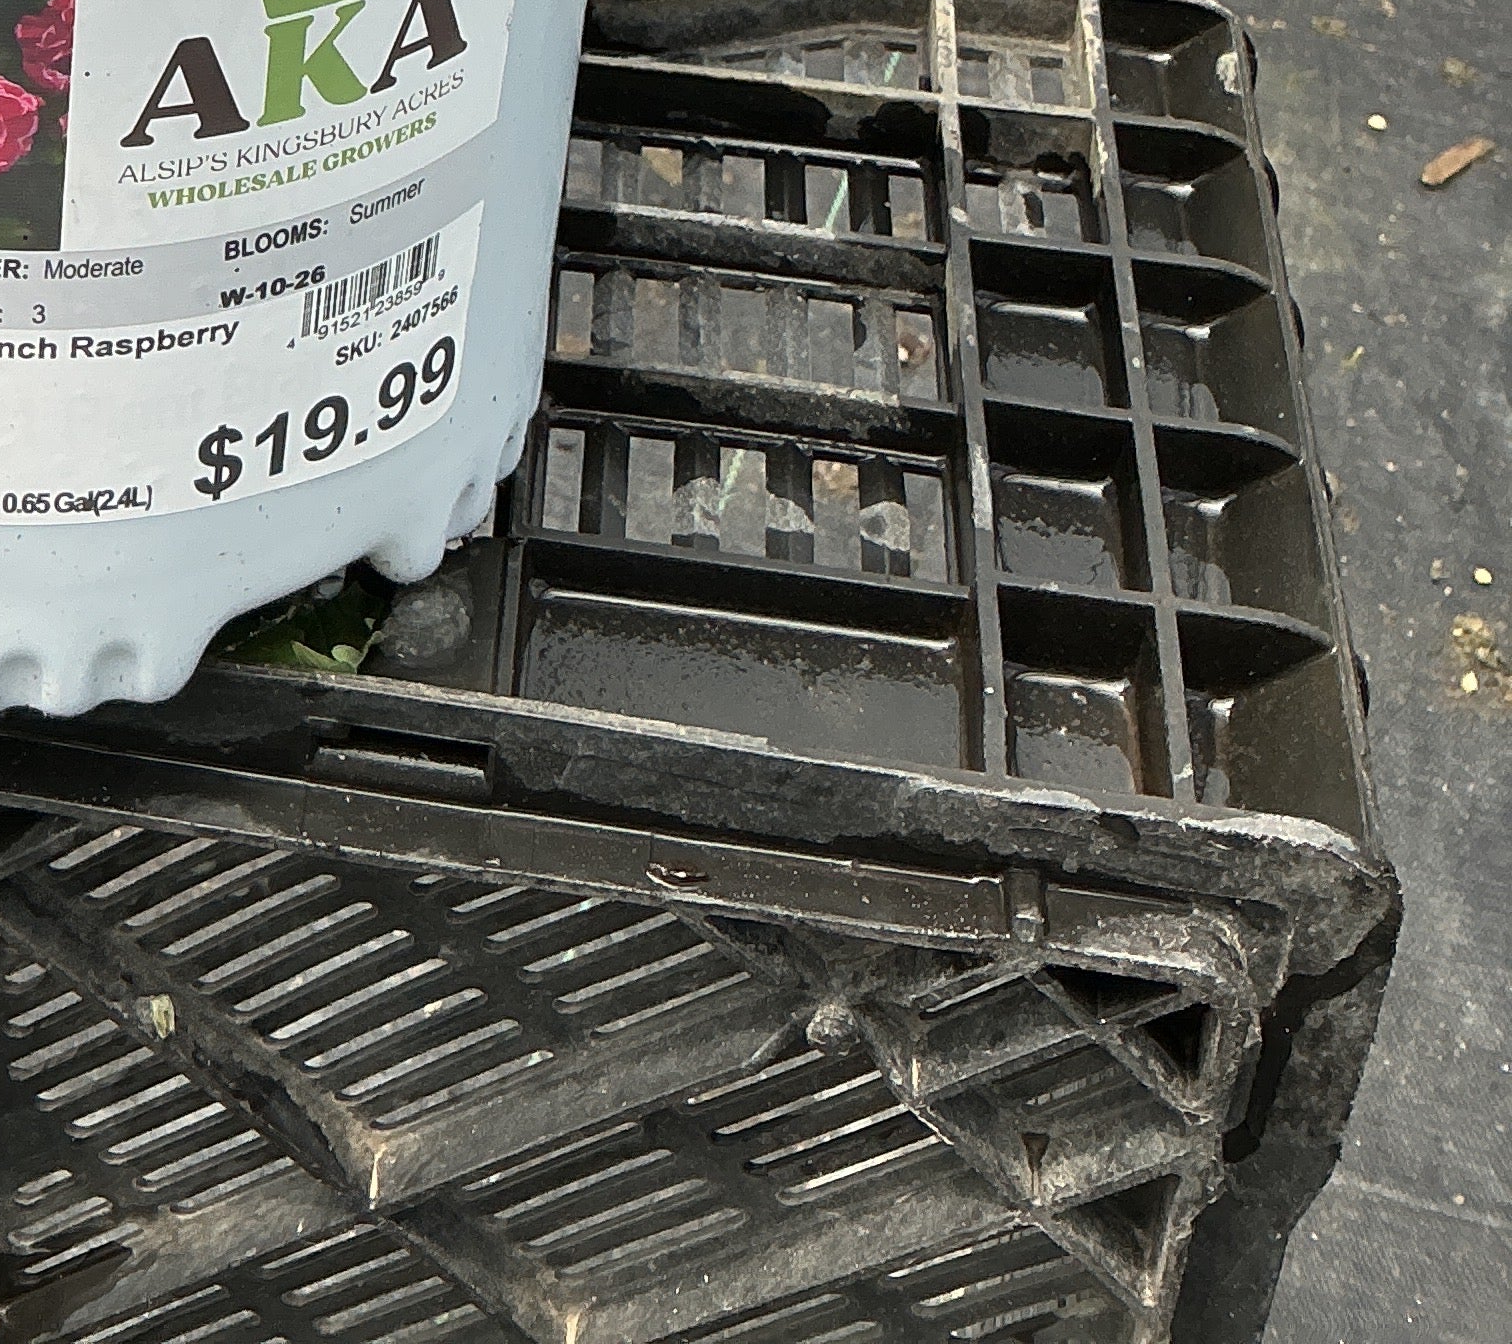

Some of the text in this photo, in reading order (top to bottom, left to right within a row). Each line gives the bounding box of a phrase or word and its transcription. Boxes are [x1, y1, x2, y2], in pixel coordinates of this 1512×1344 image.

[118, 67, 466, 184] ALSIP'S KINGSBURY ACRES
[147, 111, 438, 210] WHOLESALE GROWERS
[224, 177, 425, 262] BLOOMS: Summer
[43, 256, 144, 281] Moderate
[220, 264, 327, 310] W-10-26
[31, 303, 47, 326] 3
[70, 320, 241, 361] Raspberry
[335, 284, 460, 367] SKU: 2407566
[193, 335, 456, 502] $19.99
[2, 492, 51, 515] 0.65
